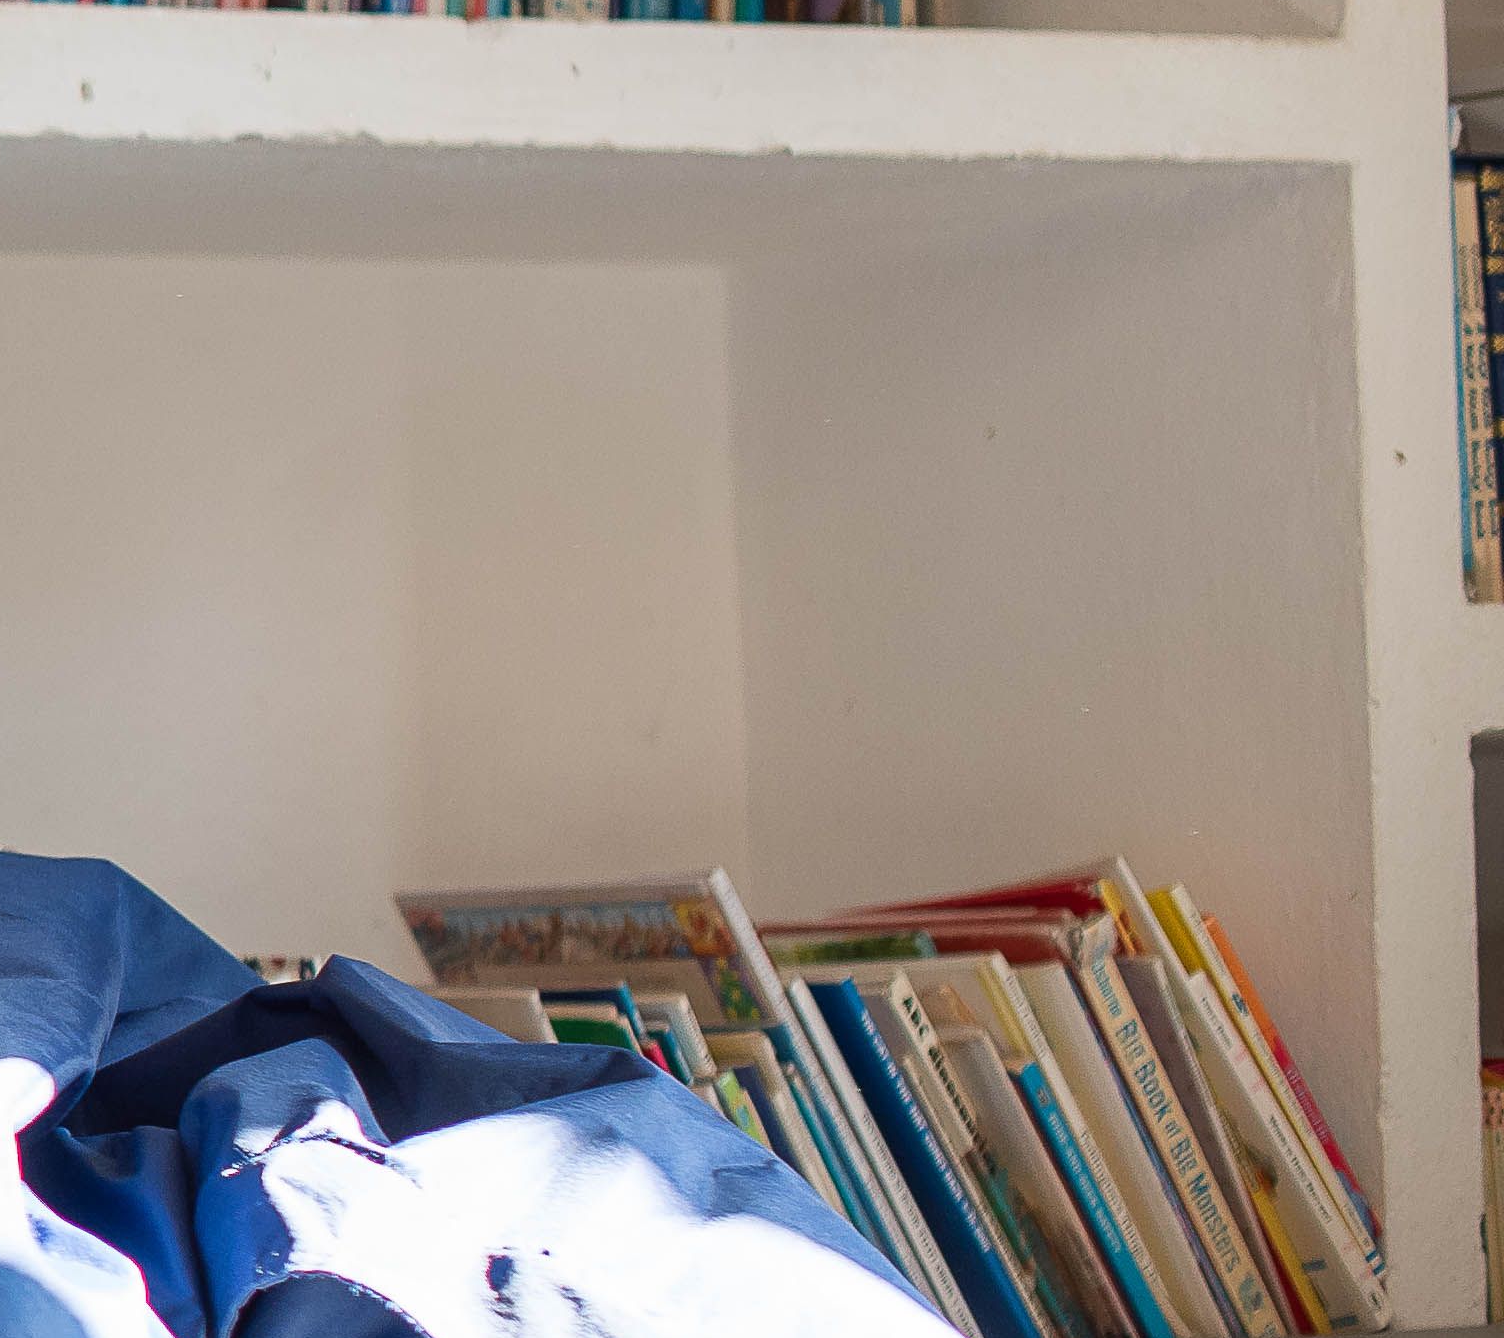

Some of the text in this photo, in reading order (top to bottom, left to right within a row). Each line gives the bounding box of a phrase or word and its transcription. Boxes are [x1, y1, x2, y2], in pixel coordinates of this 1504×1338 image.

[1111, 1016, 1152, 1065] Big
[1131, 1055, 1180, 1124] Book
[1165, 1134, 1205, 1179] Big
[1183, 1170, 1251, 1278] Monsters
